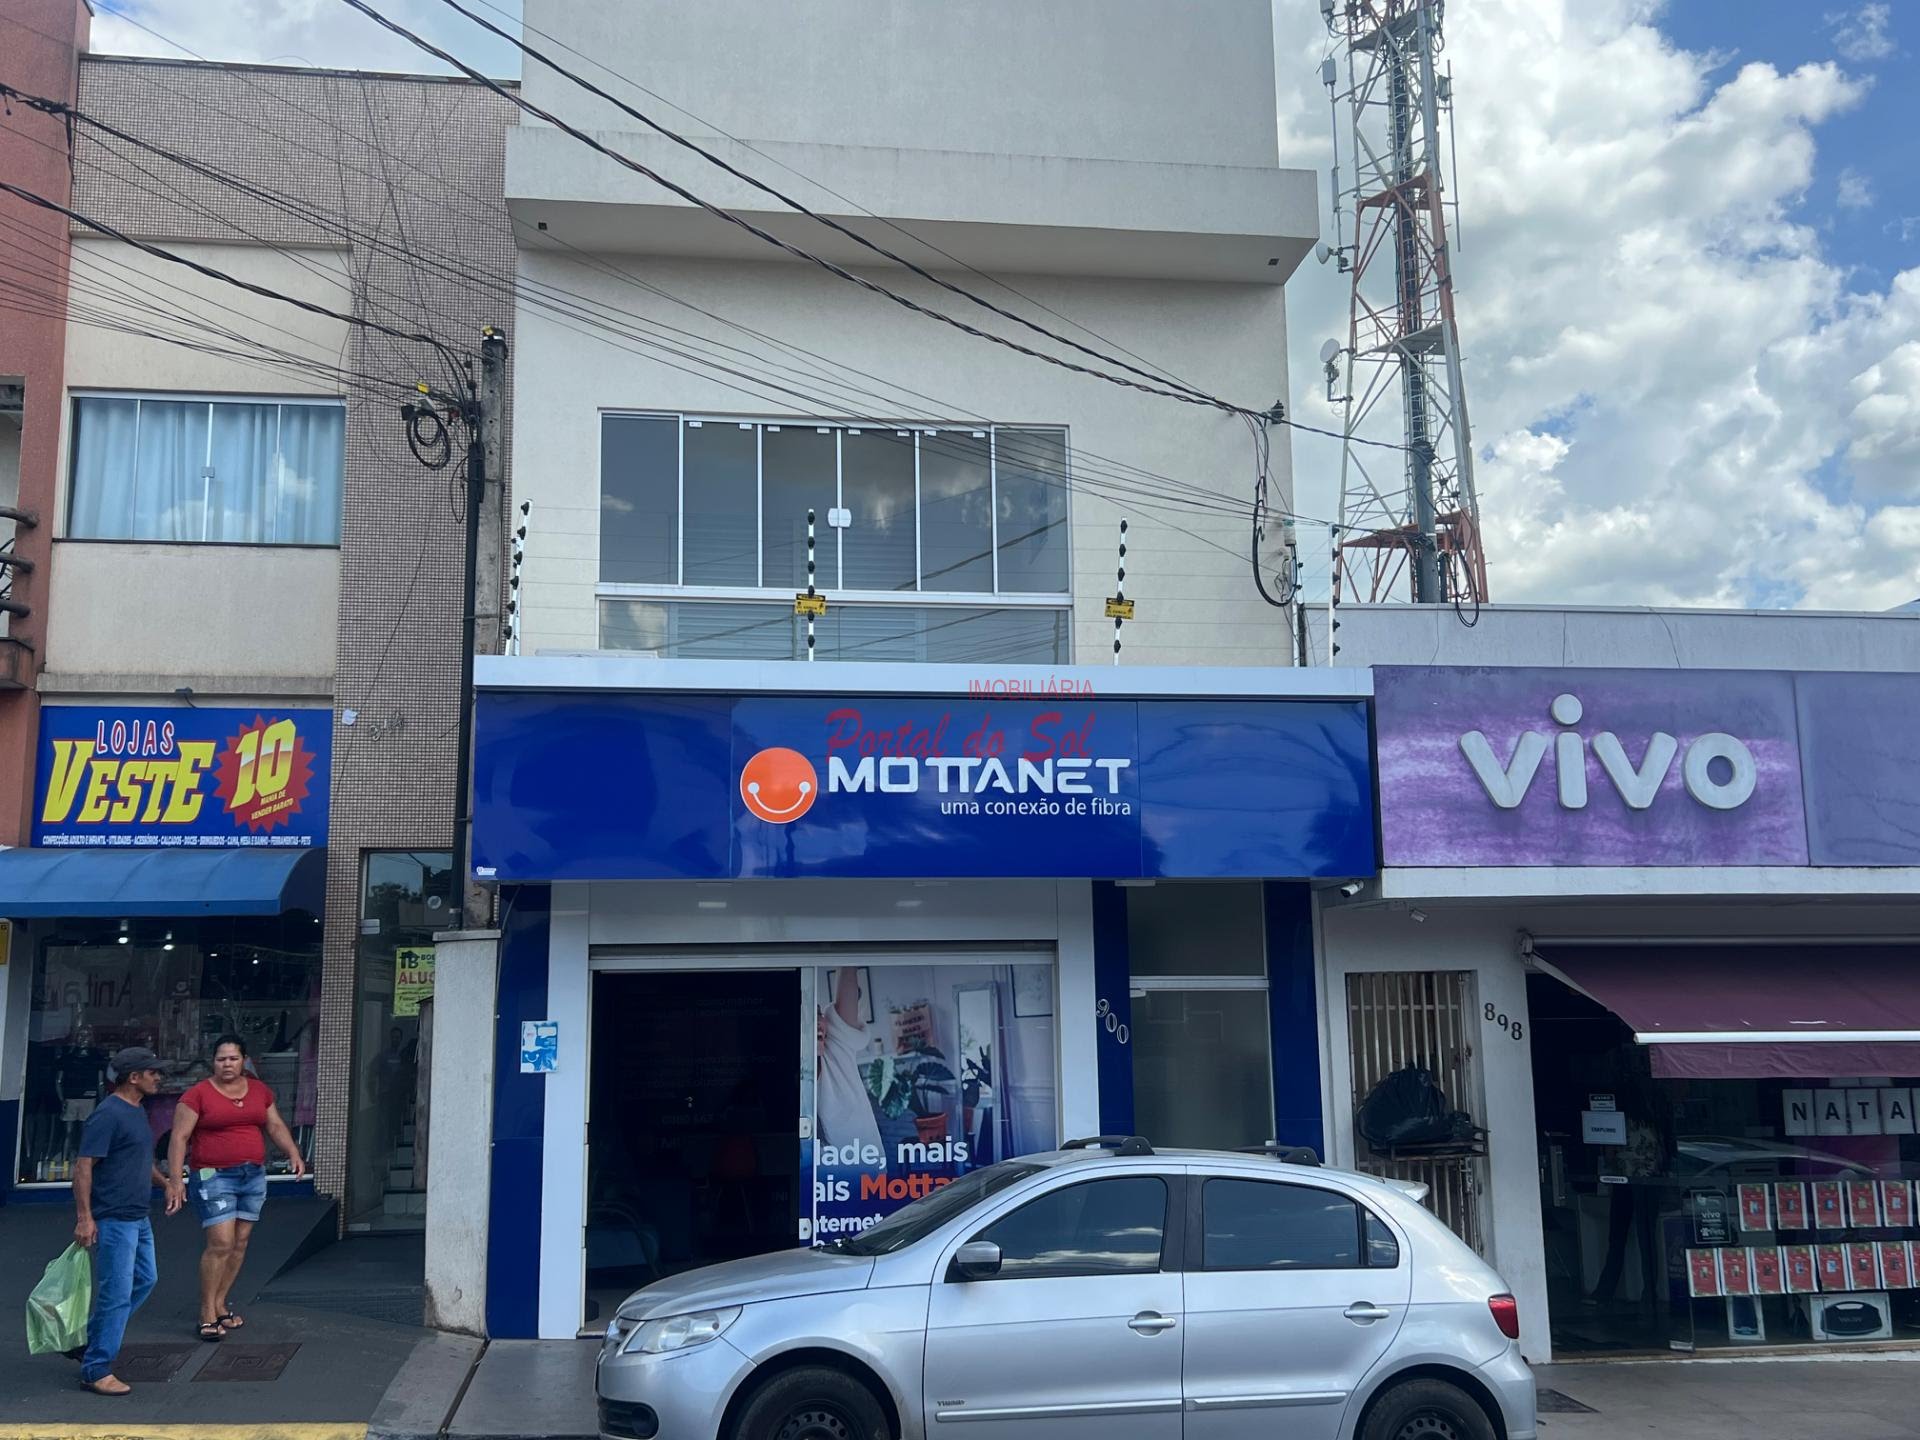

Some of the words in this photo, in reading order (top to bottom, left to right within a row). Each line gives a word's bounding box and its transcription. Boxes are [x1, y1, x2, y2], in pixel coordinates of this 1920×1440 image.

[96, 719, 175, 756] LOJAS
[1457, 693, 1757, 810] vivo
[41, 740, 217, 824] VESTE
[229, 718, 297, 809] 10
[828, 756, 1131, 794] MOTTANET
[941, 802, 979, 815] uma
[985, 798, 1060, 816] conexão
[1065, 797, 1086, 815] de
[1092, 797, 1131, 816] fibra
[1096, 998, 1130, 1044] 900
[1484, 1003, 1523, 1041] 898
[897, 1136, 969, 1164] mais
[861, 1174, 960, 1201] Motta
